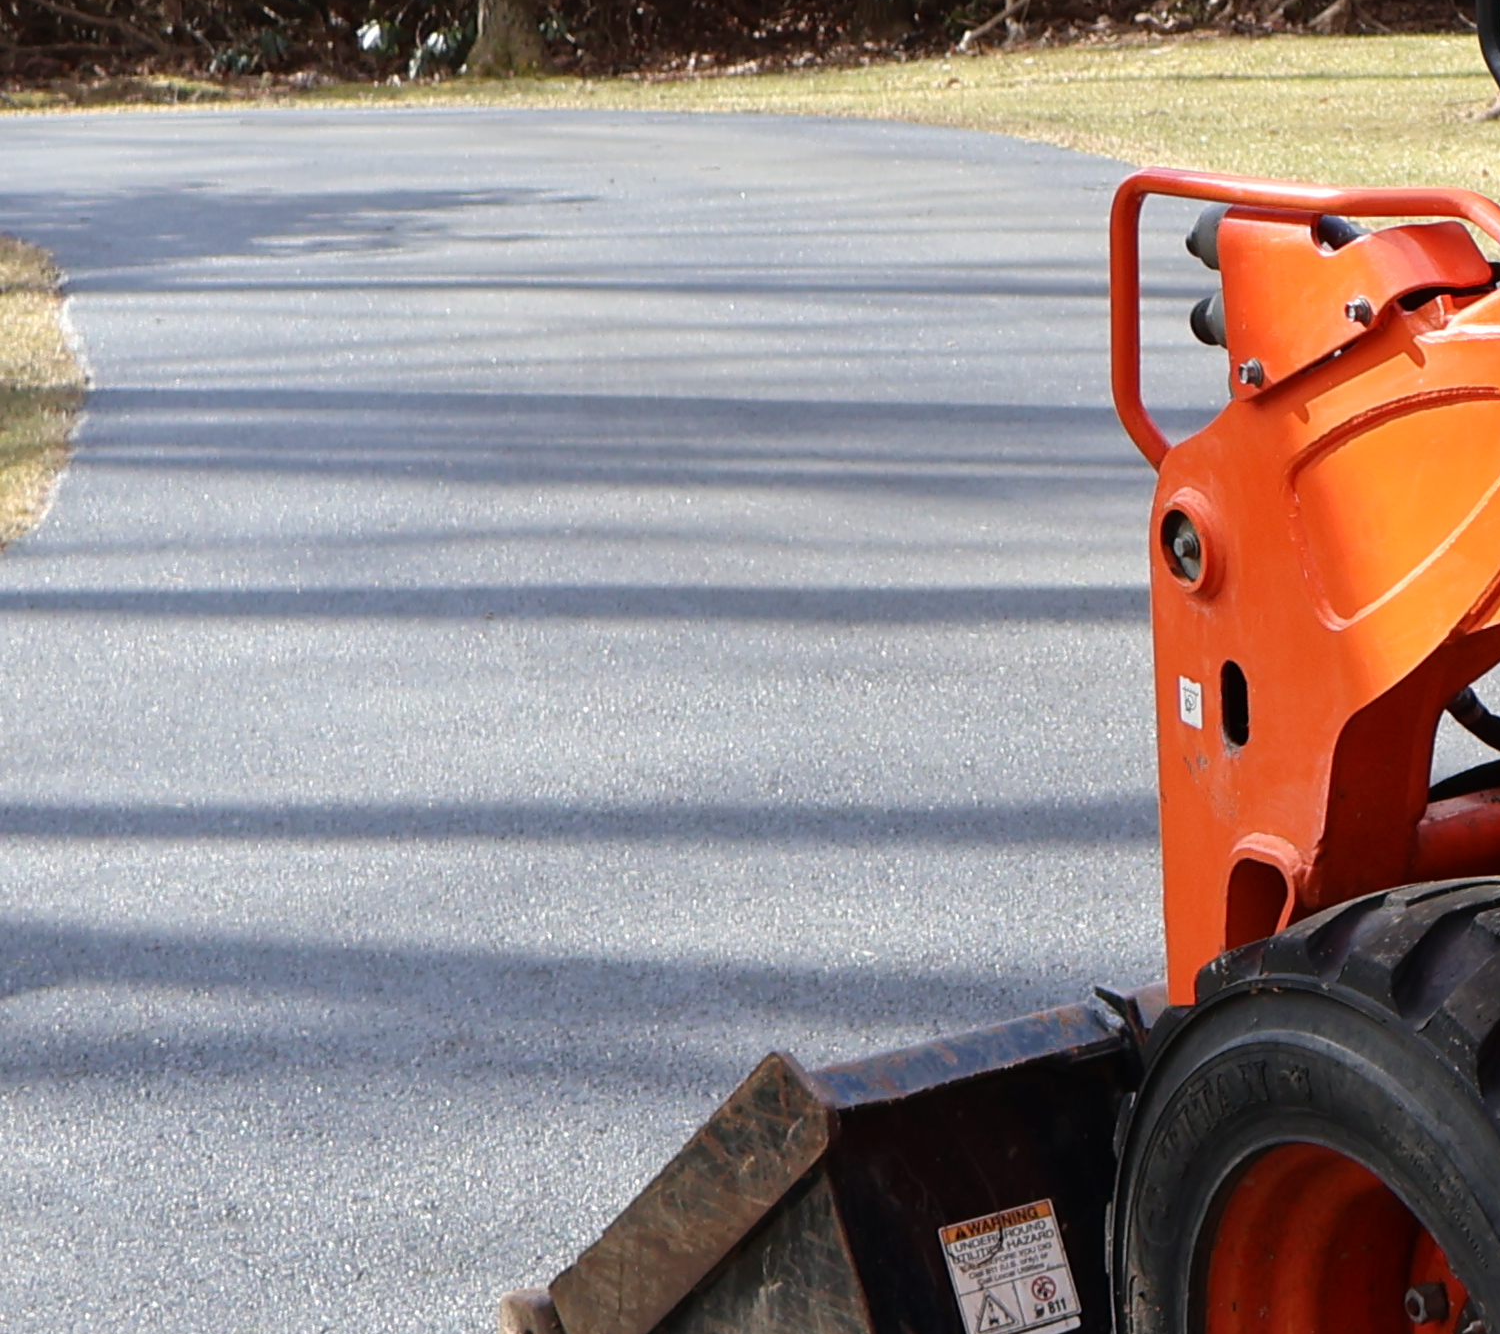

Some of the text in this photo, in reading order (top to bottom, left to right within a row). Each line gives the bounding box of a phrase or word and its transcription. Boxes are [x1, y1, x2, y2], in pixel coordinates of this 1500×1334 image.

[967, 1206, 1039, 1236] WARNING
[1006, 1229, 1055, 1250] HAZARD
[1048, 1297, 1067, 1314] 811
